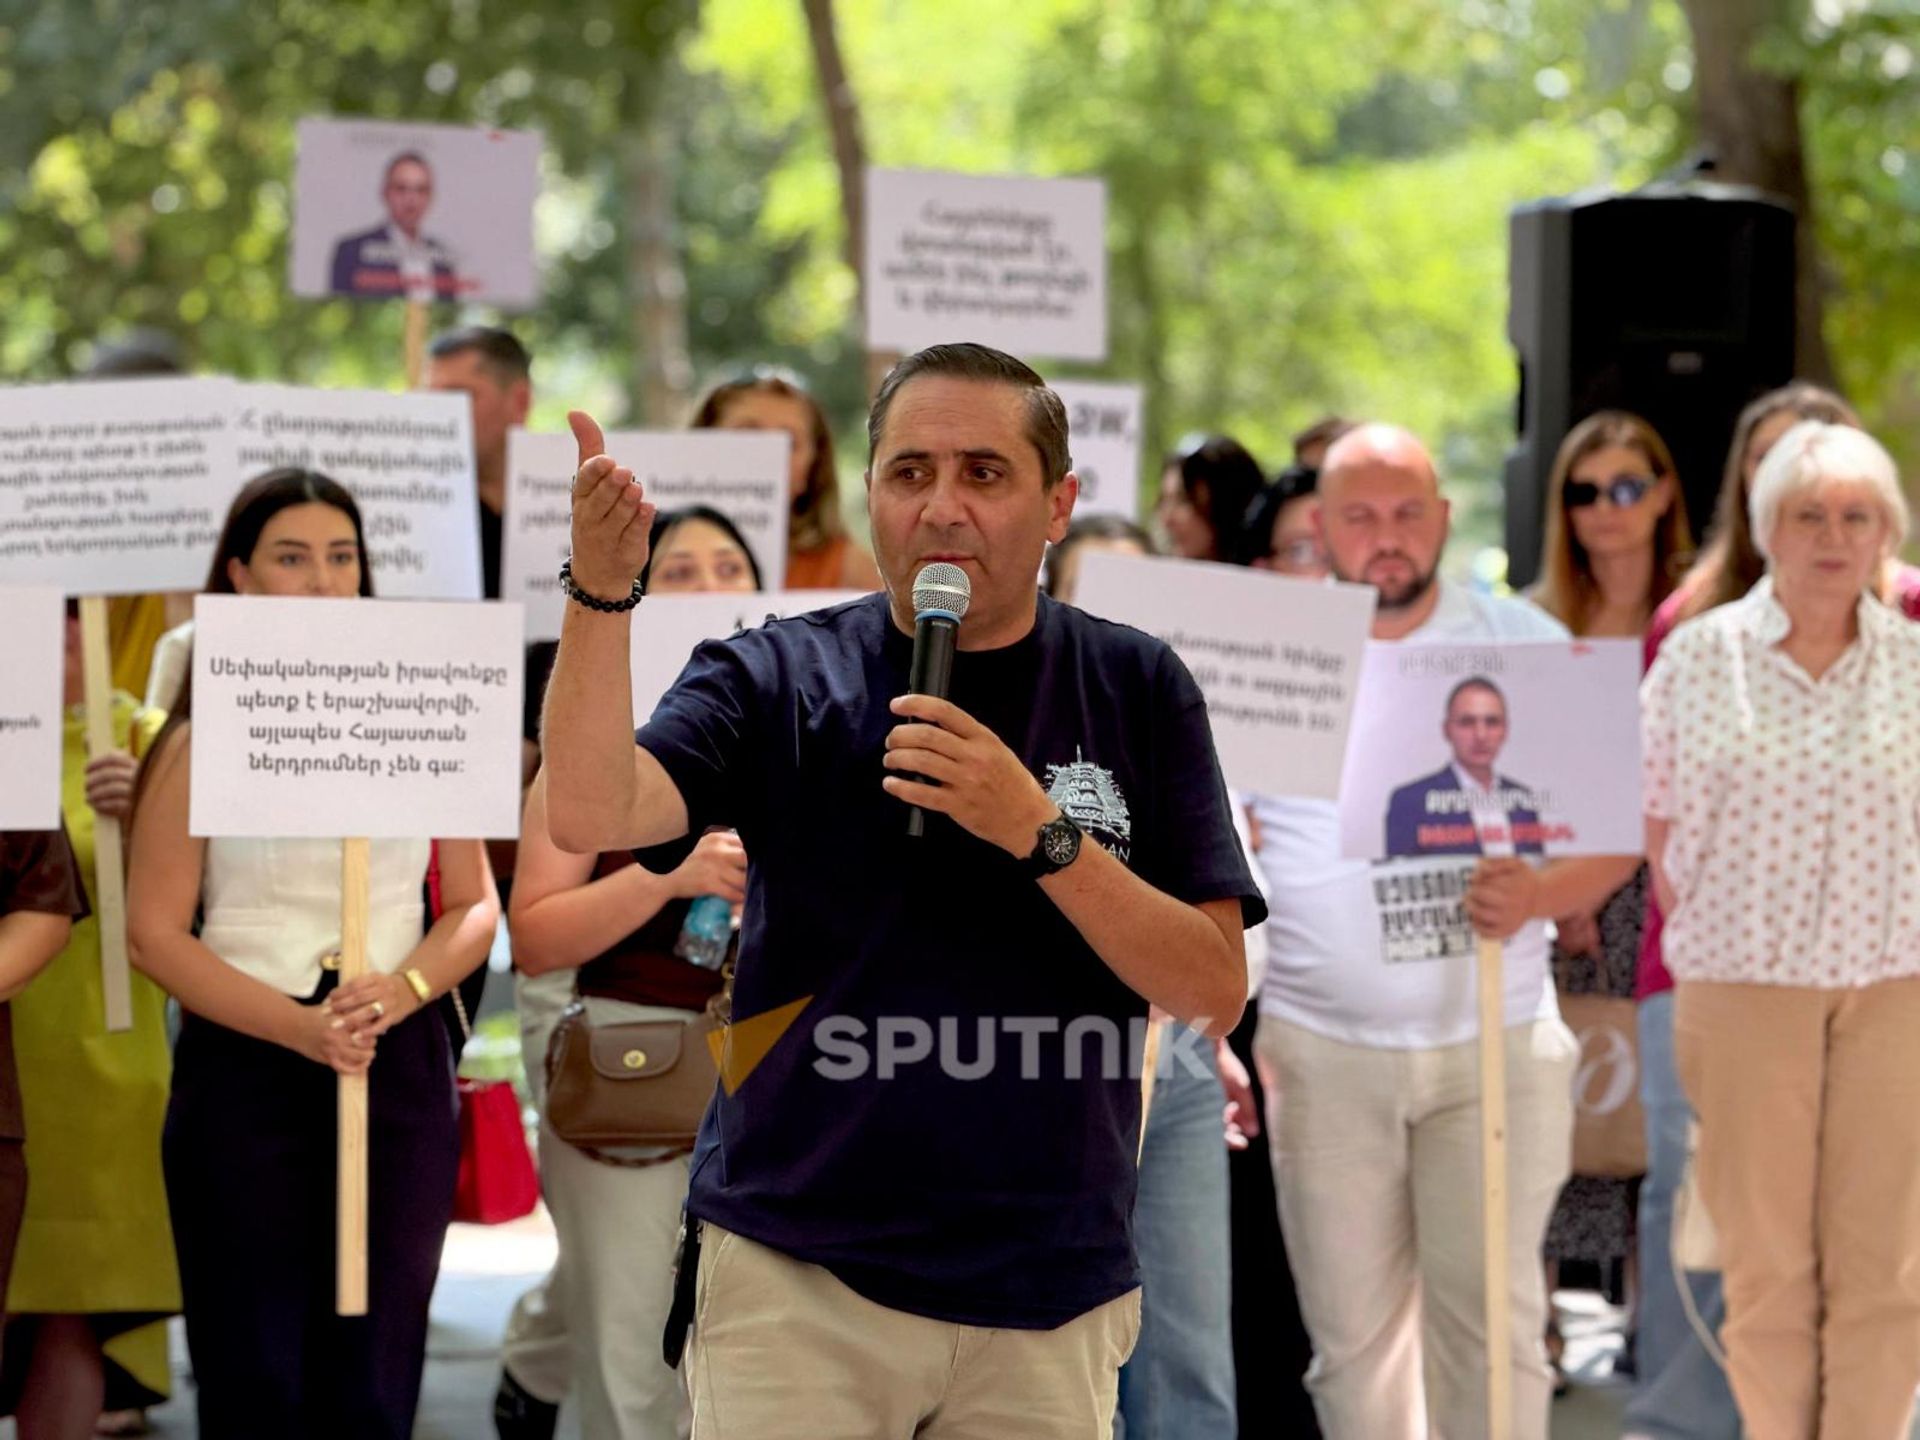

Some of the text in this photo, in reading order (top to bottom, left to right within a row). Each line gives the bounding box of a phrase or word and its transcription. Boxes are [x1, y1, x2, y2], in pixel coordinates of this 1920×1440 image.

[210, 657, 507, 687] Սեփականության իրավունքը
[236, 688, 299, 712] պետք
[306, 691, 316, 712] է
[249, 723, 466, 746] այլապես Հայաստան
[249, 751, 381, 776] ներդրումներ
[388, 754, 420, 777] չեն
